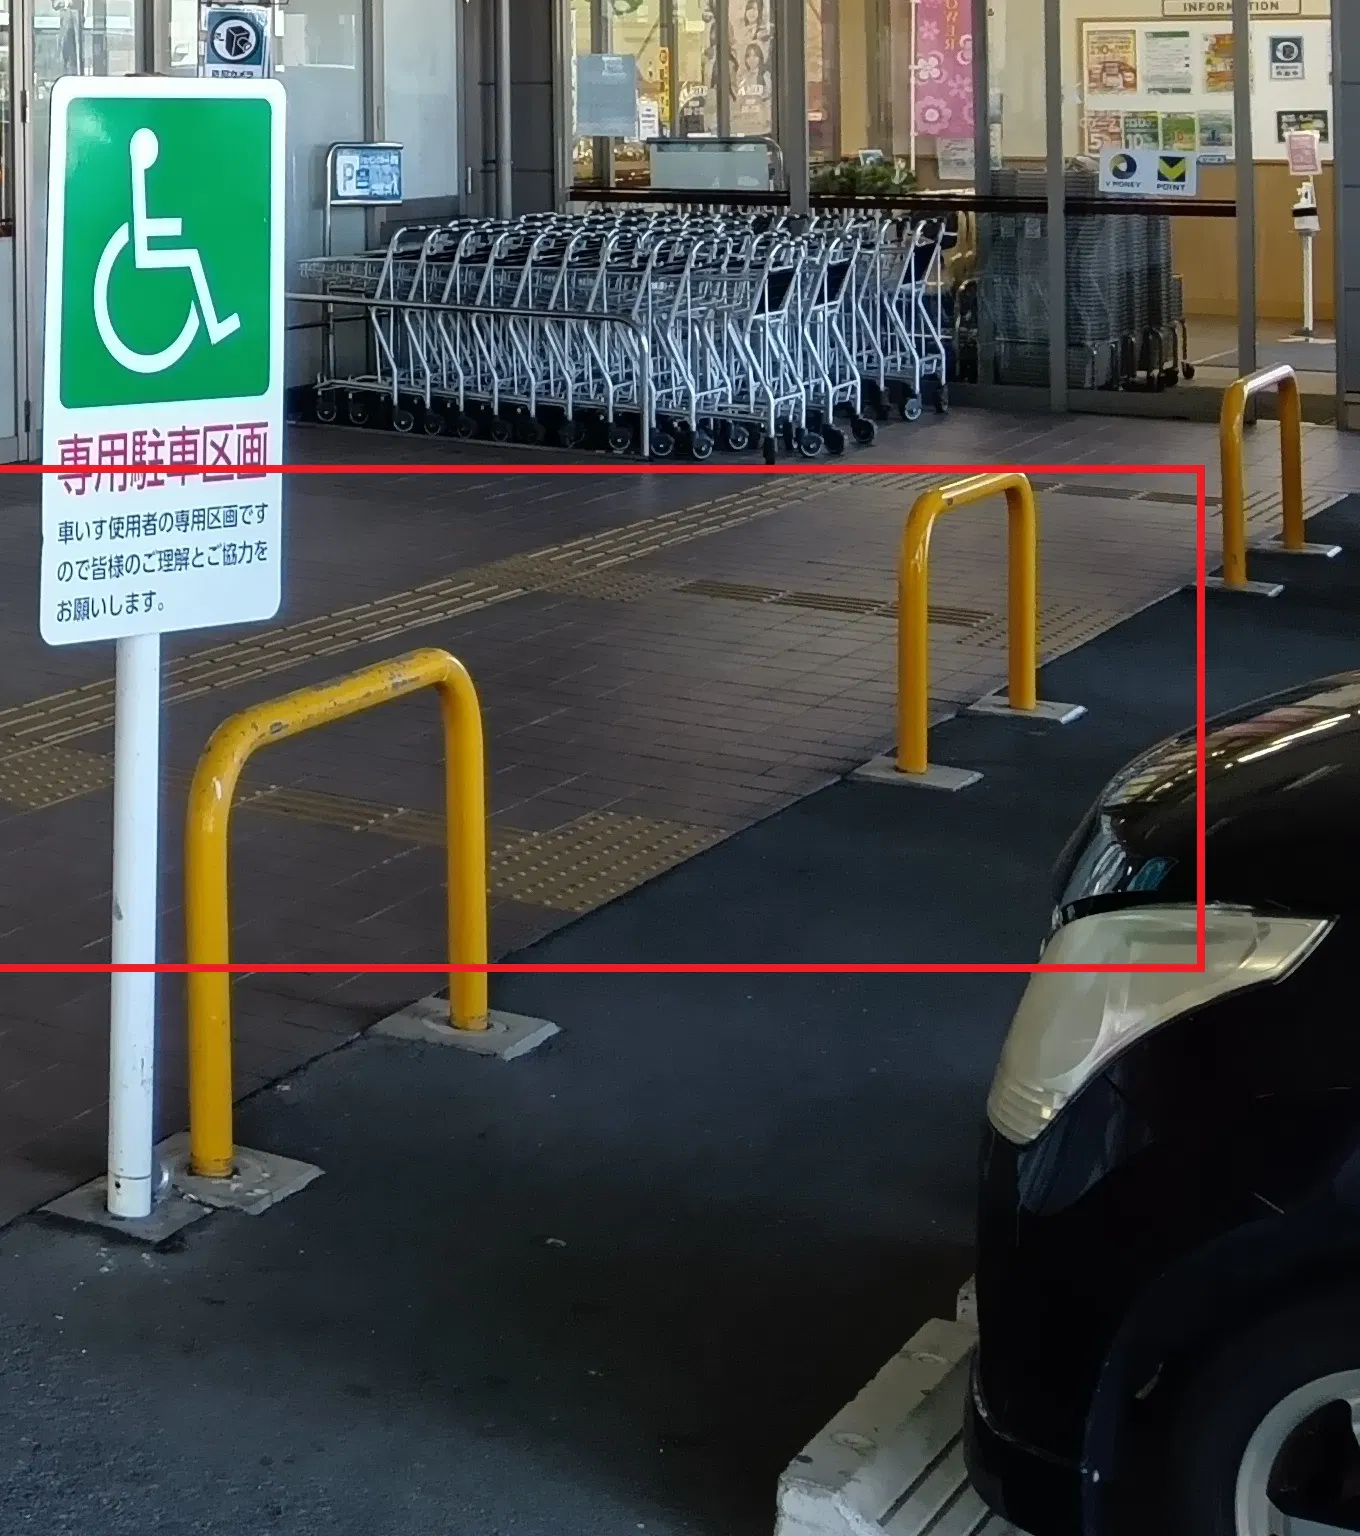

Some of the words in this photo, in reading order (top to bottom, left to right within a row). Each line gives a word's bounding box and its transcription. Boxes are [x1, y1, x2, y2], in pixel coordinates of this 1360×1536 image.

[57, 421, 270, 496] 専用駐車区画
[57, 502, 269, 545] 車いす使用者の専用区画です
[57, 540, 269, 583] ので皆様のご理解とご協力を
[56, 589, 165, 623] お願いします。
